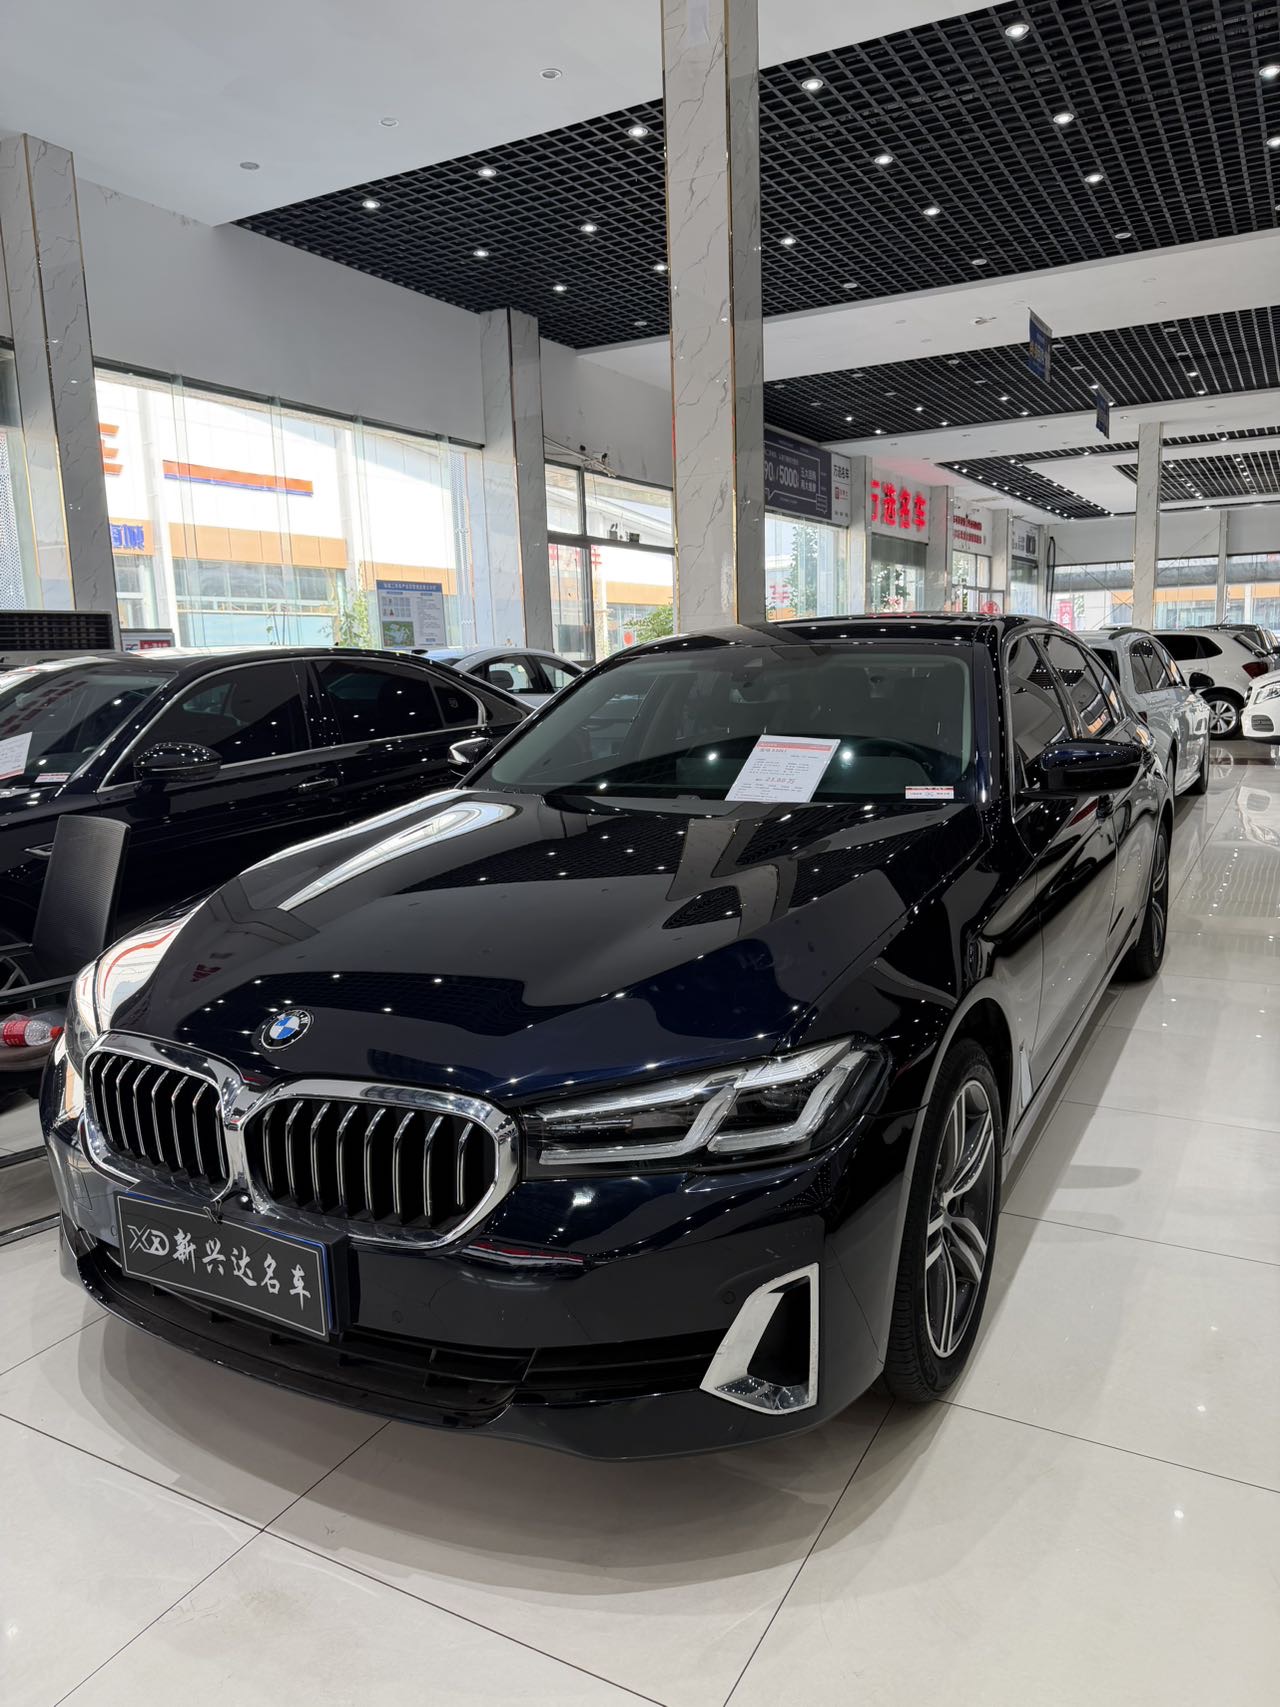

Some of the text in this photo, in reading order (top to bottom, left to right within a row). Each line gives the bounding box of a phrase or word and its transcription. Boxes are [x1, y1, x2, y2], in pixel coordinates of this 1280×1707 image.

[172, 1227, 311, 1311] 新兴达名车
